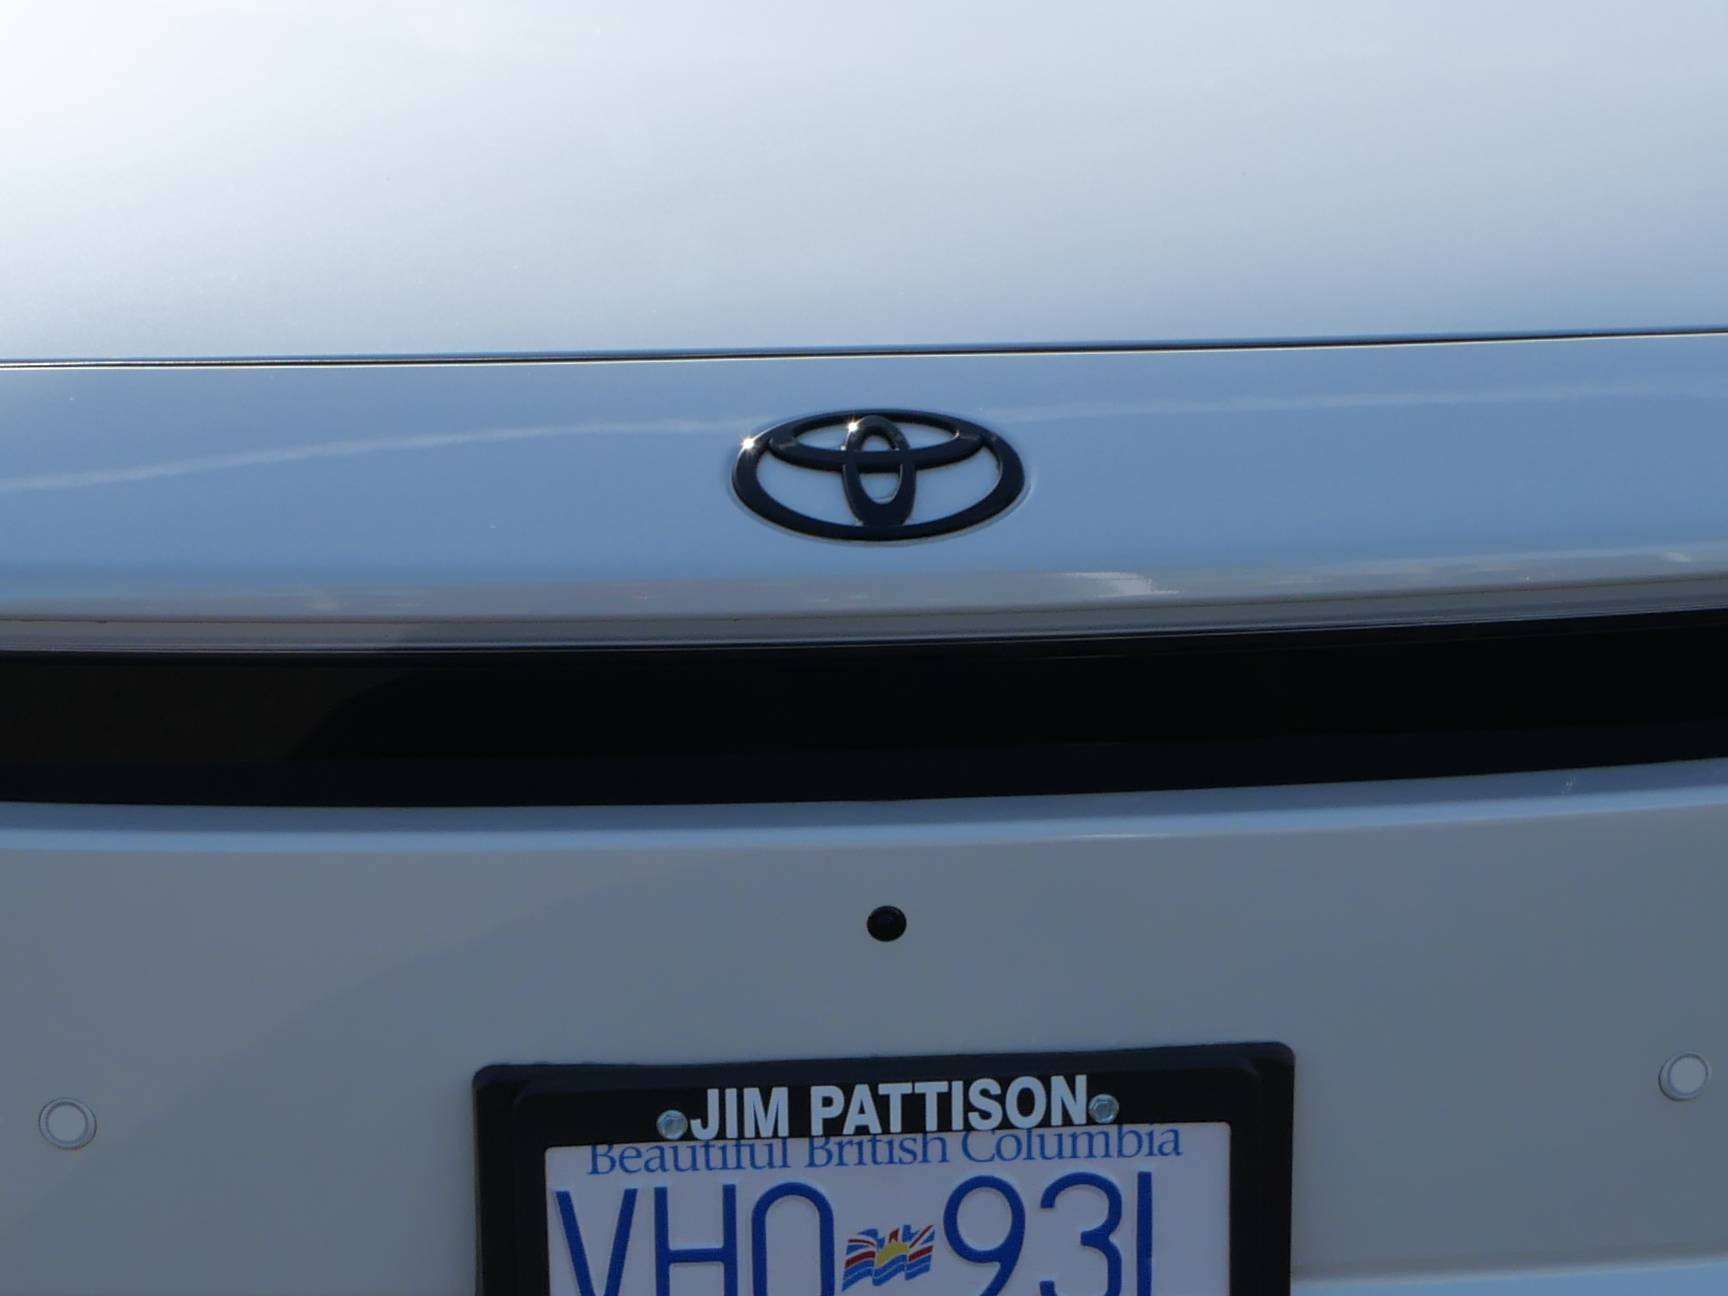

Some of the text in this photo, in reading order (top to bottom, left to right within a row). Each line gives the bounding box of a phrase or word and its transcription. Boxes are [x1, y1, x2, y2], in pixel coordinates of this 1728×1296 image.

[690, 1074, 1088, 1141] JIM PATTISON
[586, 1122, 1184, 1176] Beautiful British Columbia
